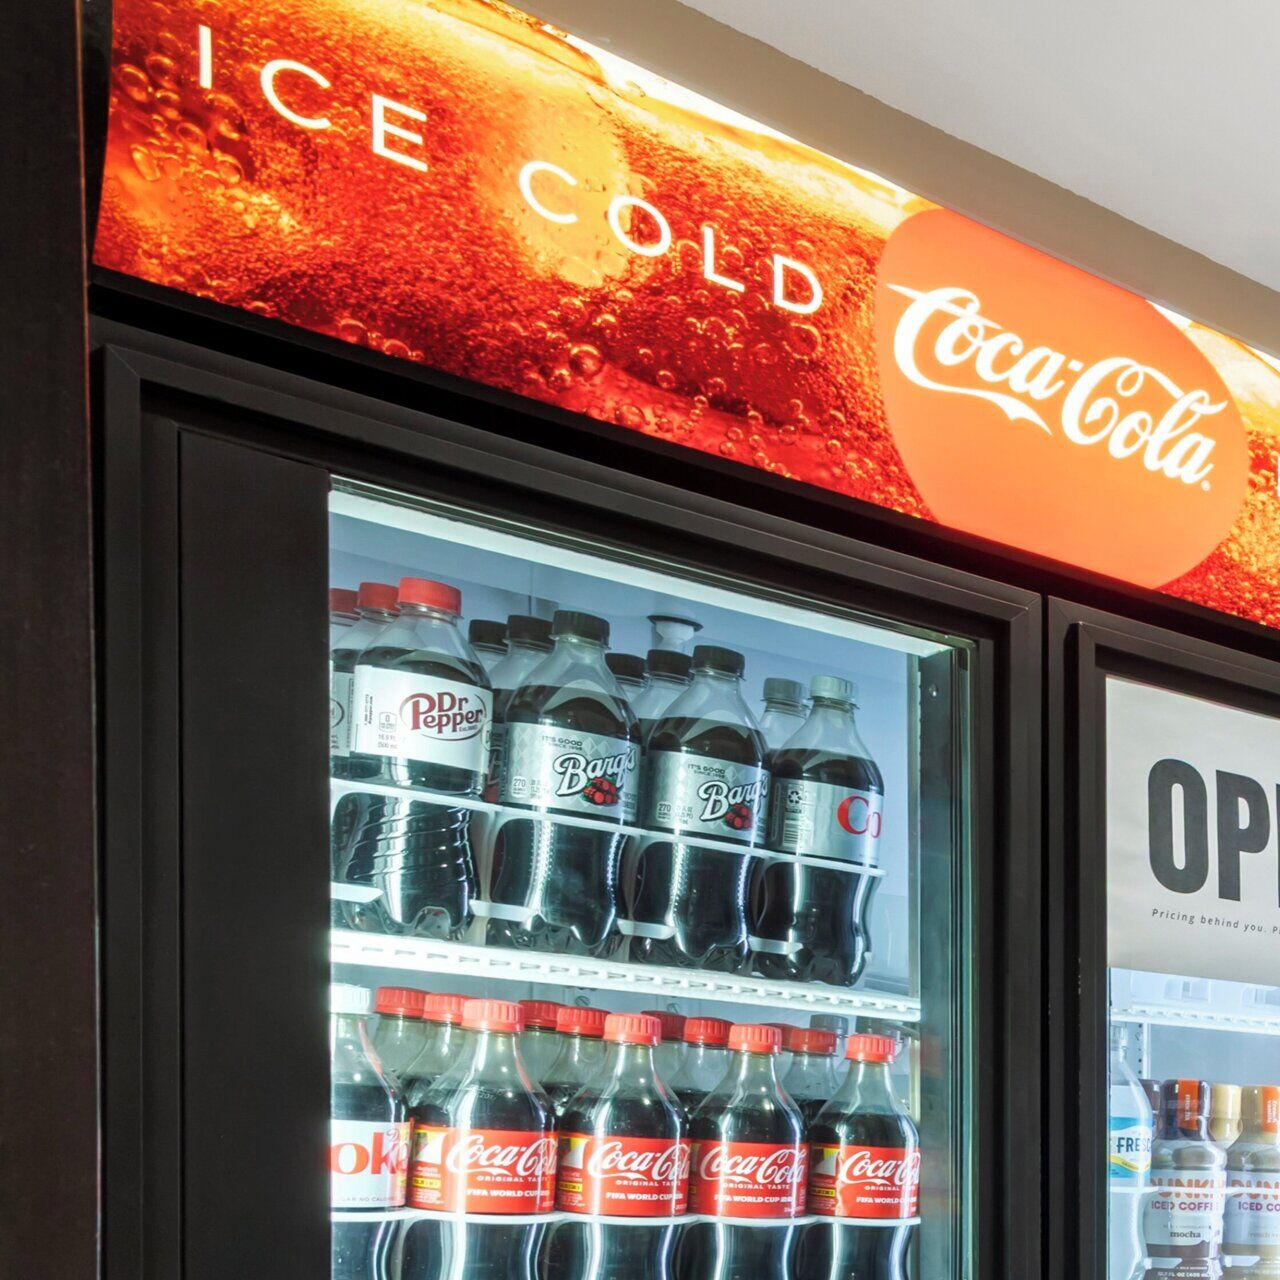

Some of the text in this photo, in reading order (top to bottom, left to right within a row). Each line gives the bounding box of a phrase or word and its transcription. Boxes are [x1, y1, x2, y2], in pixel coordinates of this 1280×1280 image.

[197, 24, 825, 315] ICE COLD
[886, 281, 1230, 489] Coca-Cola
[437, 691, 469, 713] Dr
[410, 692, 484, 734] Pepper
[1152, 908, 1195, 925] Pricing
[1200, 915, 1239, 929] behind
[1243, 923, 1267, 933] you.
[476, 1175, 524, 1183] ORIGINAL
[490, 1189, 522, 1197] WORLD
[627, 1192, 658, 1201] WORLD
[733, 1195, 763, 1203] WORLD
[1238, 1202, 1263, 1211] ICED
[1170, 1230, 1202, 1239] mocha
